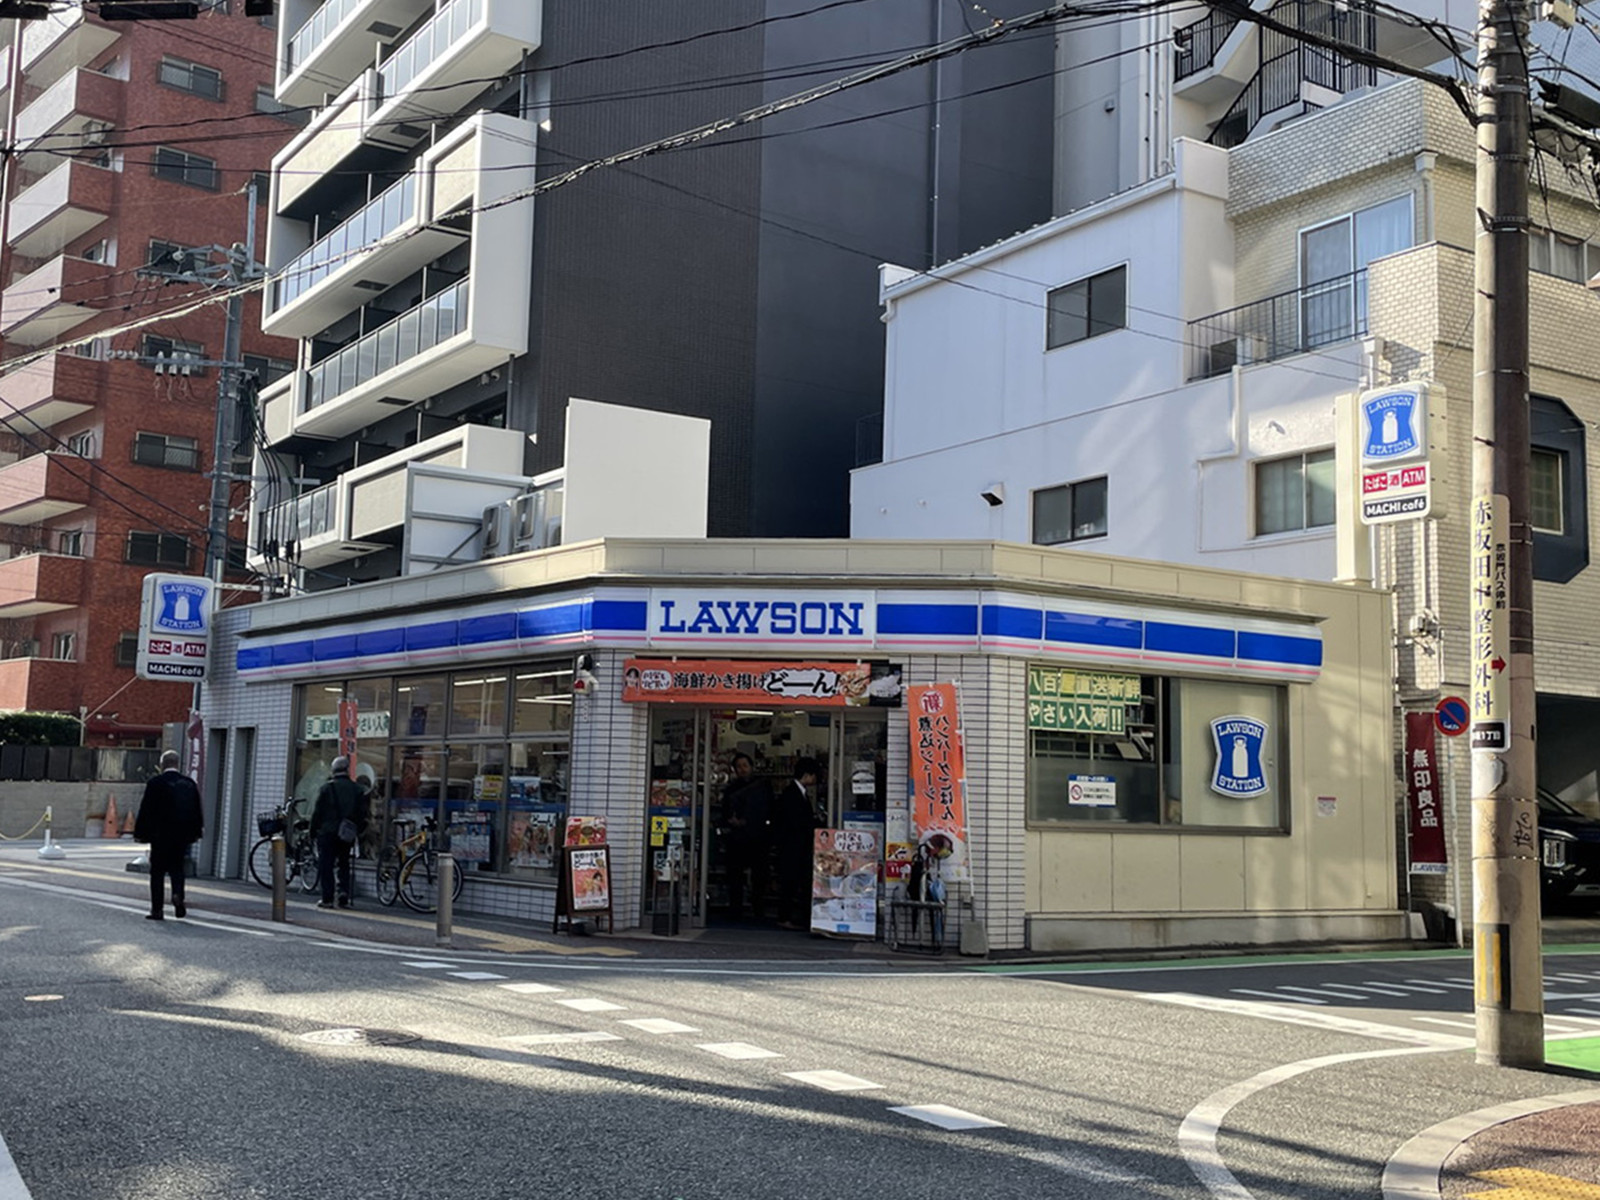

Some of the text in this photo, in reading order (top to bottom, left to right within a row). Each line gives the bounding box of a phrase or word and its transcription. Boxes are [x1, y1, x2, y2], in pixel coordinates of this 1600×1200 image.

[1368, 397, 1412, 414] LAWSON
[1368, 438, 1412, 454] STATION
[1403, 469, 1425, 484] ATM
[1366, 498, 1425, 516] MACHI café
[163, 585, 204, 597] LAWSON
[161, 617, 201, 629] STATION
[660, 601, 864, 635] LAWSON
[184, 645, 205, 656] ATM
[149, 665, 181, 674] MACHI
[1029, 671, 1140, 699] 八百直送新鮮
[1217, 723, 1262, 738] LAWSON
[1218, 776, 1262, 792] STATION
[1413, 748, 1438, 828] 無印良品
